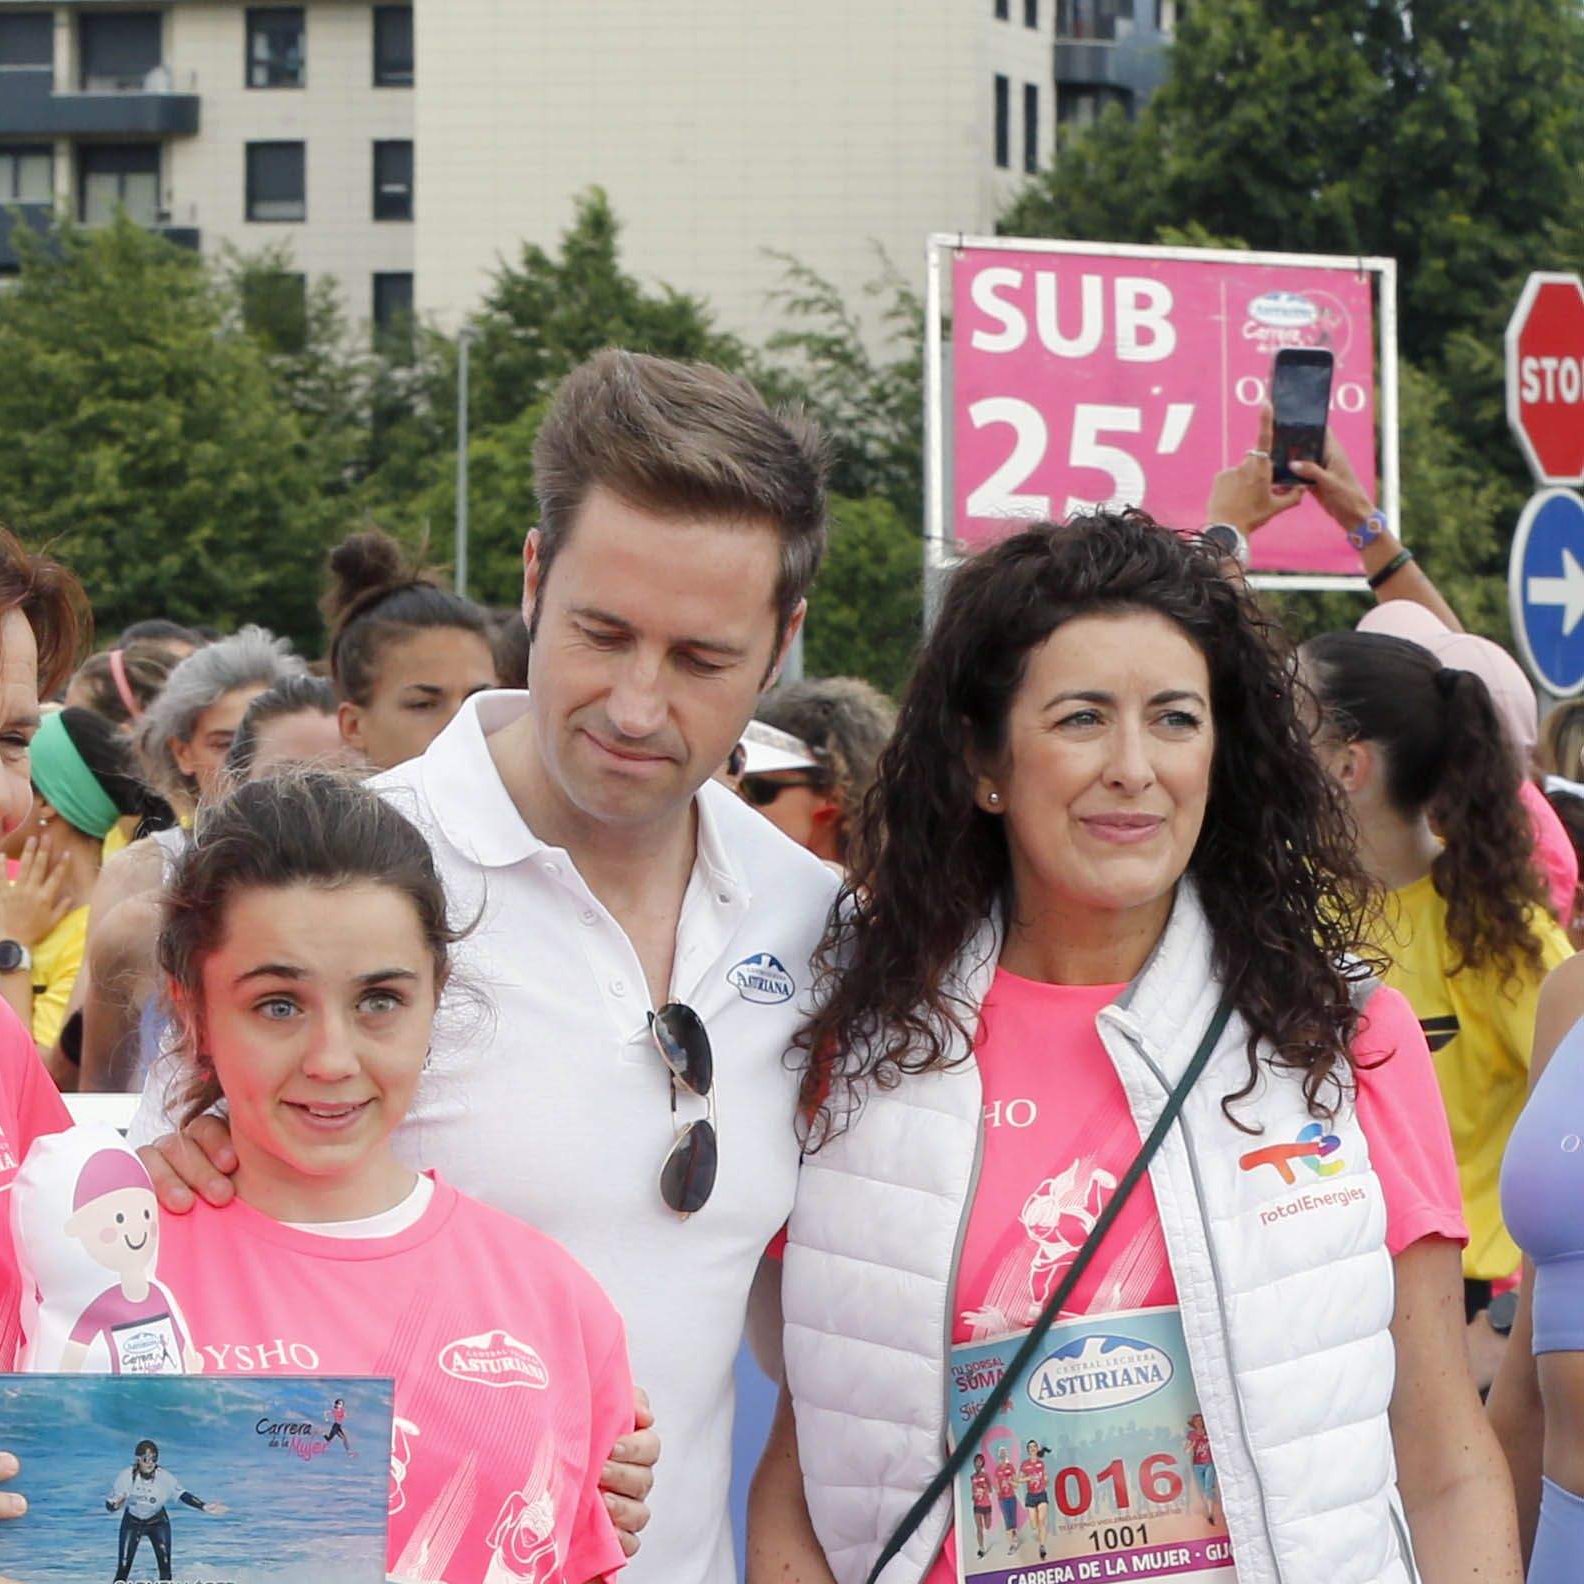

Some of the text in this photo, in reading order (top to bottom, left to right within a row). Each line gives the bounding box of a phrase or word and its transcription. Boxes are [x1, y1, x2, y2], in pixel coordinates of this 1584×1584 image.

[970, 266, 1178, 363] SUB
[1521, 356, 1584, 404] STO
[1260, 1188, 1366, 1225] TotalEnergies
[203, 1339, 320, 1371] YSHO
[1038, 1364, 1164, 1400] ASTURIANA
[255, 1417, 312, 1436] Carrera
[268, 1438, 279, 1448] de
[289, 1436, 331, 1461] Mujer
[1054, 1453, 1183, 1517] 016
[1088, 1523, 1151, 1552] 1001
[1079, 1560, 1101, 1580] DE
[1105, 1556, 1128, 1576] LA
[1132, 1548, 1191, 1572] MUJER
